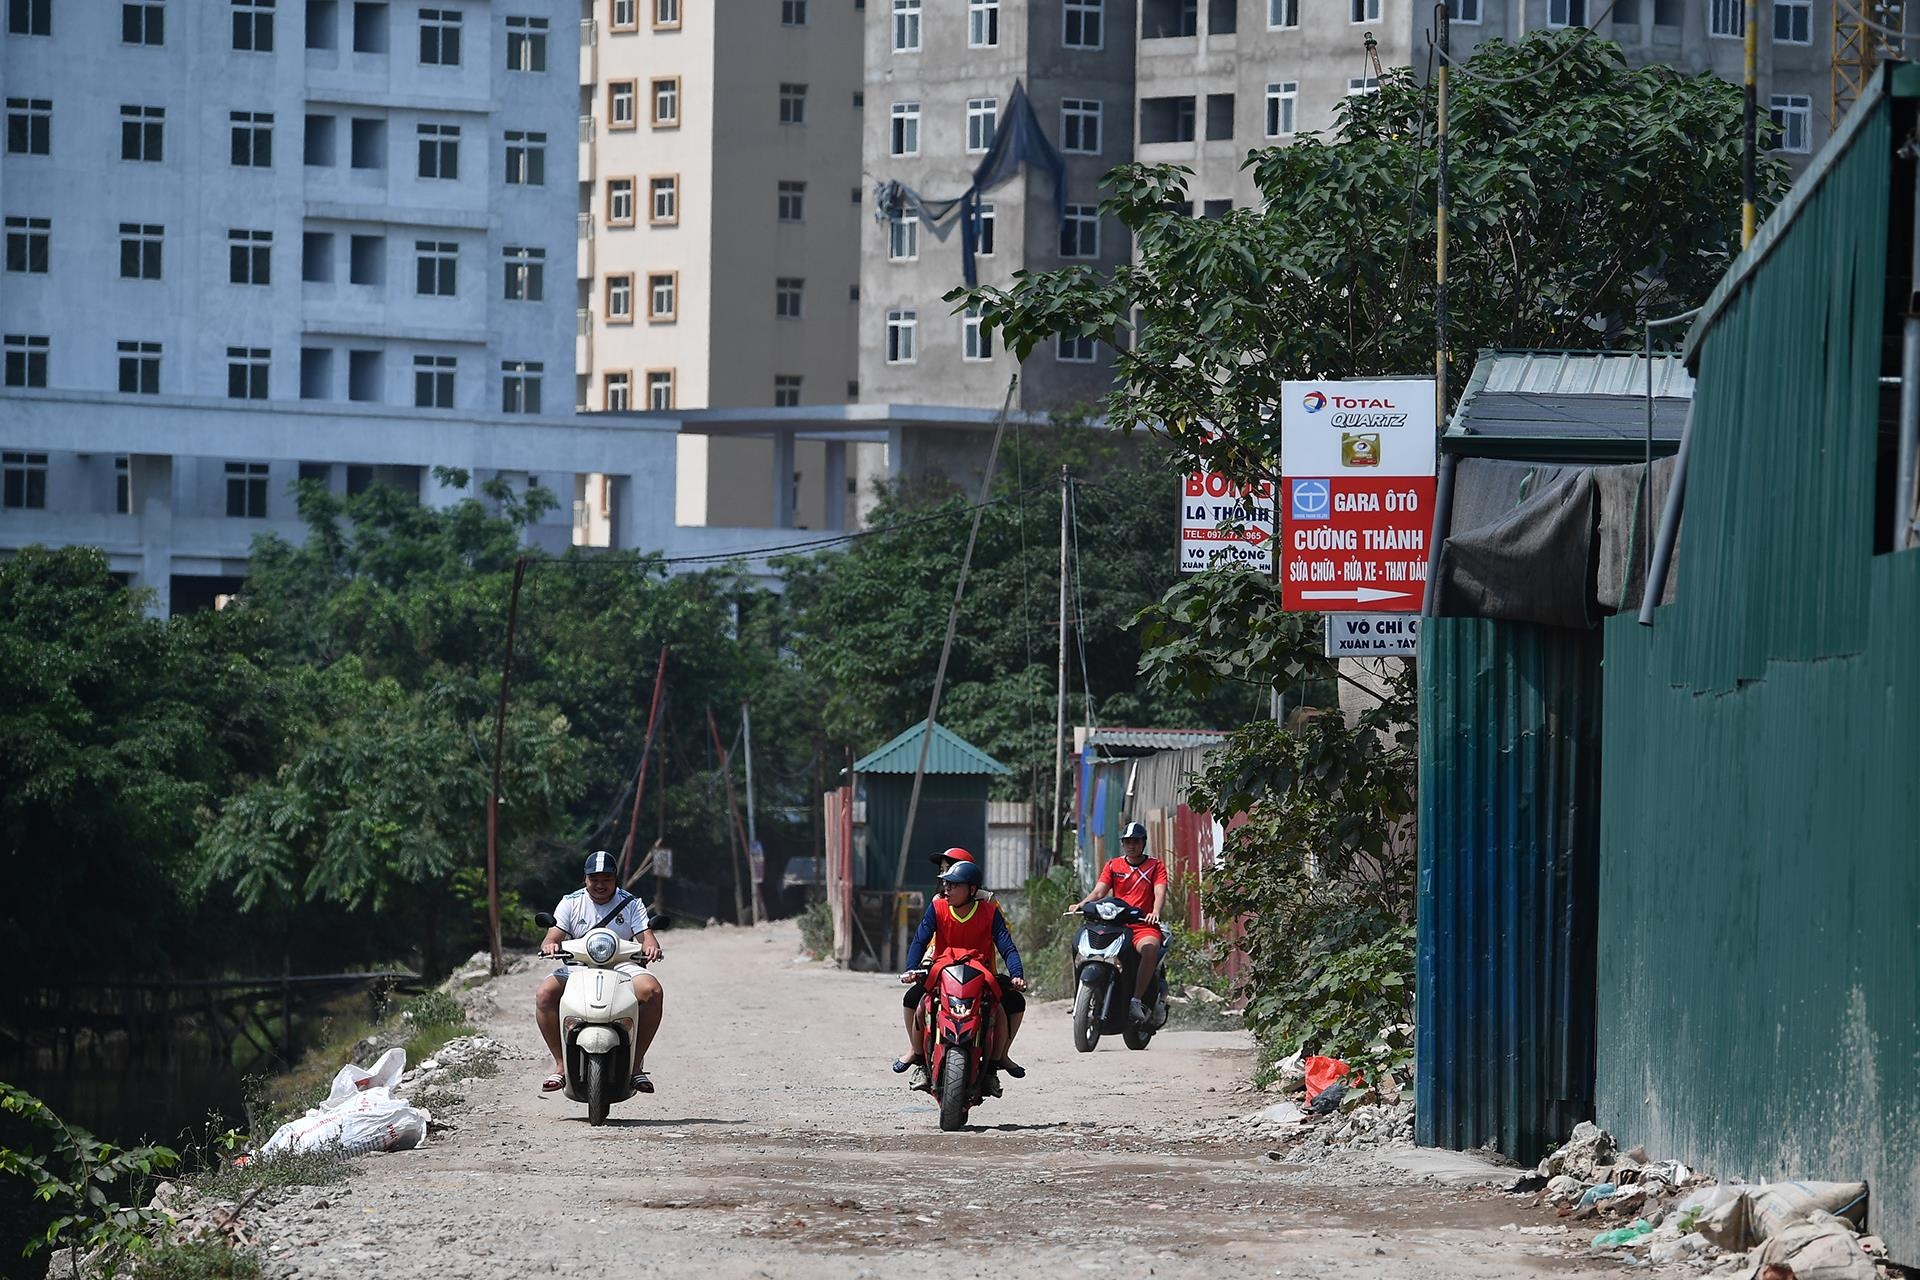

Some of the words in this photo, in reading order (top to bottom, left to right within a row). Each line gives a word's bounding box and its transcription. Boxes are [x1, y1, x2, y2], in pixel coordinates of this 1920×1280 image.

[1331, 412, 1408, 428] QUARTZ
[1334, 493, 1380, 512] GARA
[1385, 489, 1418, 512] ÔTÔ
[1186, 505, 1206, 520] LA
[1185, 529, 1205, 539] TEL:
[1294, 525, 1357, 550] CƯỜNG
[1362, 525, 1424, 550] THÀNH
[1290, 555, 1309, 581] SỬA
[1311, 558, 1335, 582] CHỮA
[1344, 555, 1362, 582] RỬA
[1365, 561, 1377, 581] XE
[1385, 561, 1407, 581] THAY
[1376, 618, 1402, 634] CHÍ
[1339, 639, 1369, 650] XUÂN
[1373, 640, 1386, 649] LA
